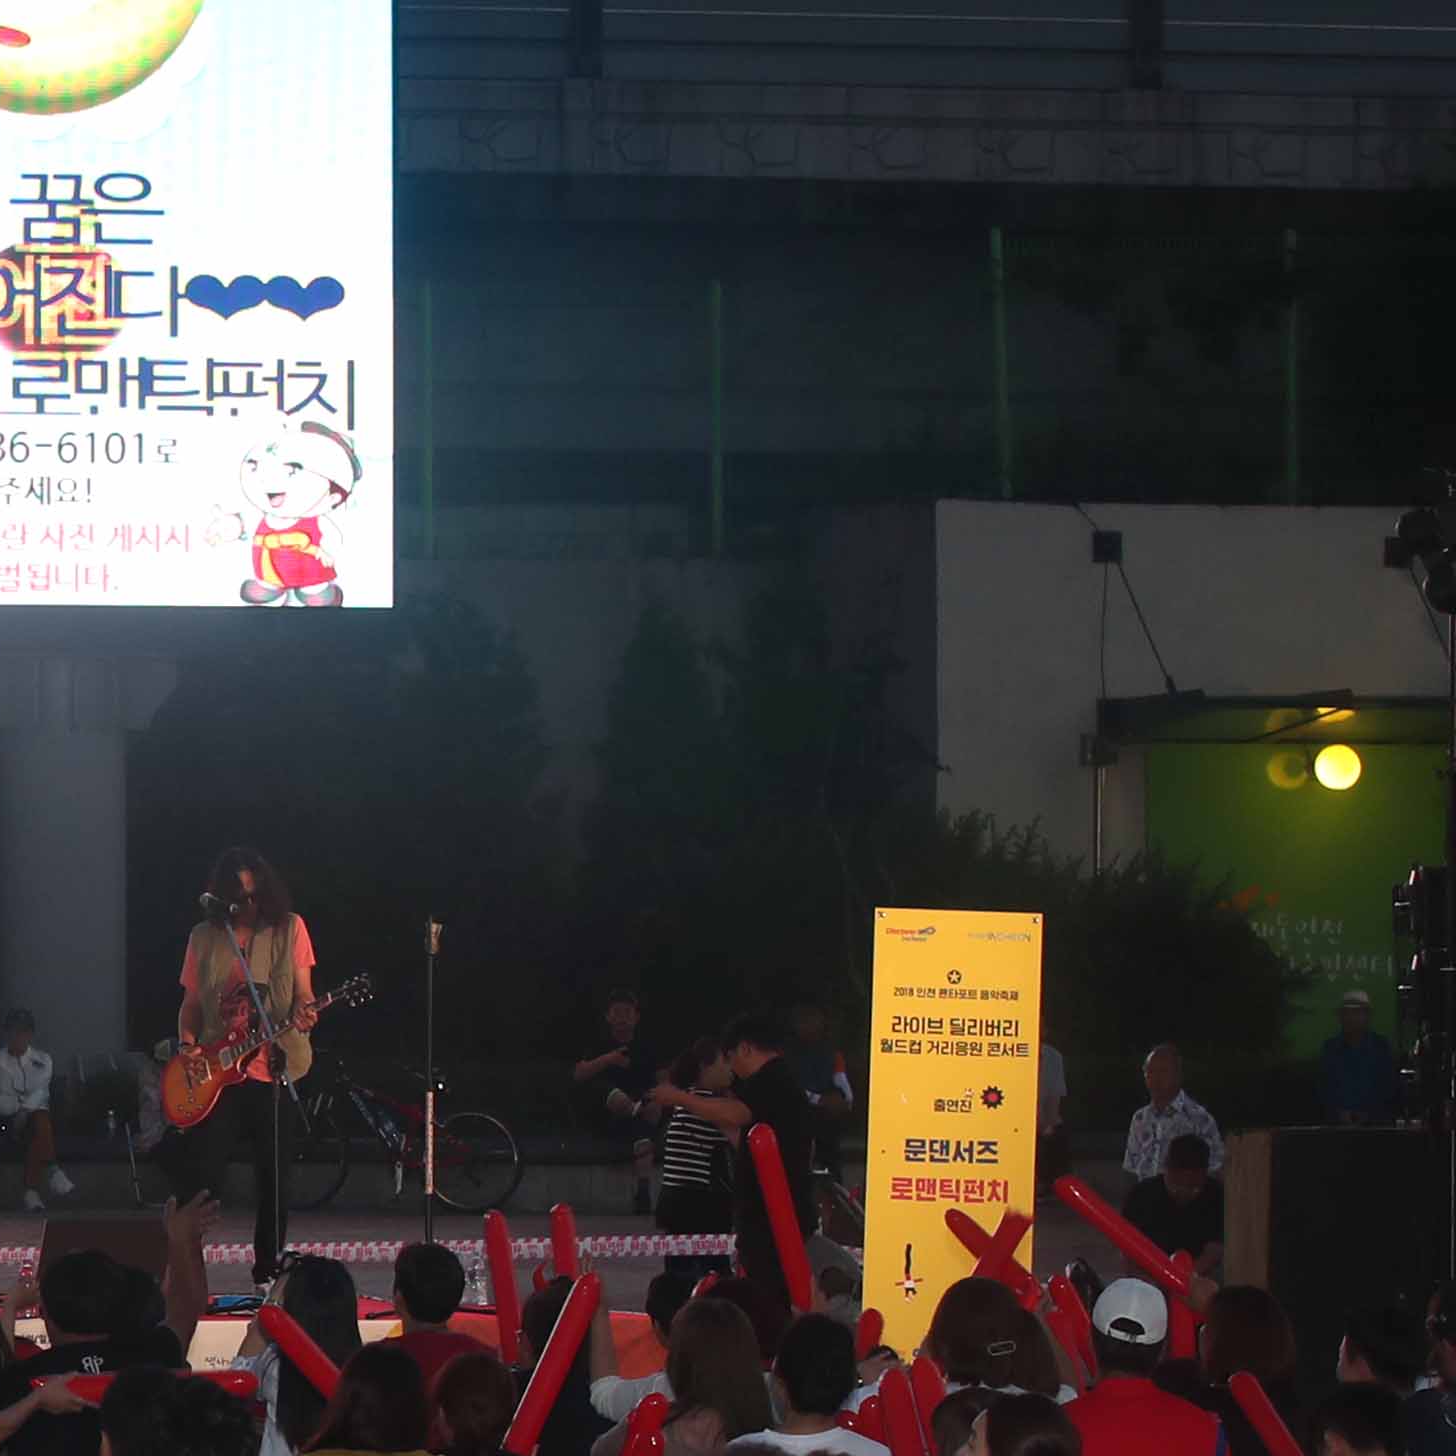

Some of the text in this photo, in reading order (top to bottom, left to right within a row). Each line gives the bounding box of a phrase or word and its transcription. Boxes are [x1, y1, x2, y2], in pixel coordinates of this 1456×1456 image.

[9, 172, 166, 246] 꿈은
[893, 986, 914, 997] 2018
[916, 987, 937, 999] 인천
[891, 1015, 1019, 1037] 라이브 딜리버리
[880, 1038, 1030, 1058] 월드컵 거리응원 콘서트
[933, 1098, 973, 1113] 출연진
[903, 1138, 999, 1164] 문댄서즈
[889, 1176, 1010, 1204] 로맨틱펀치
